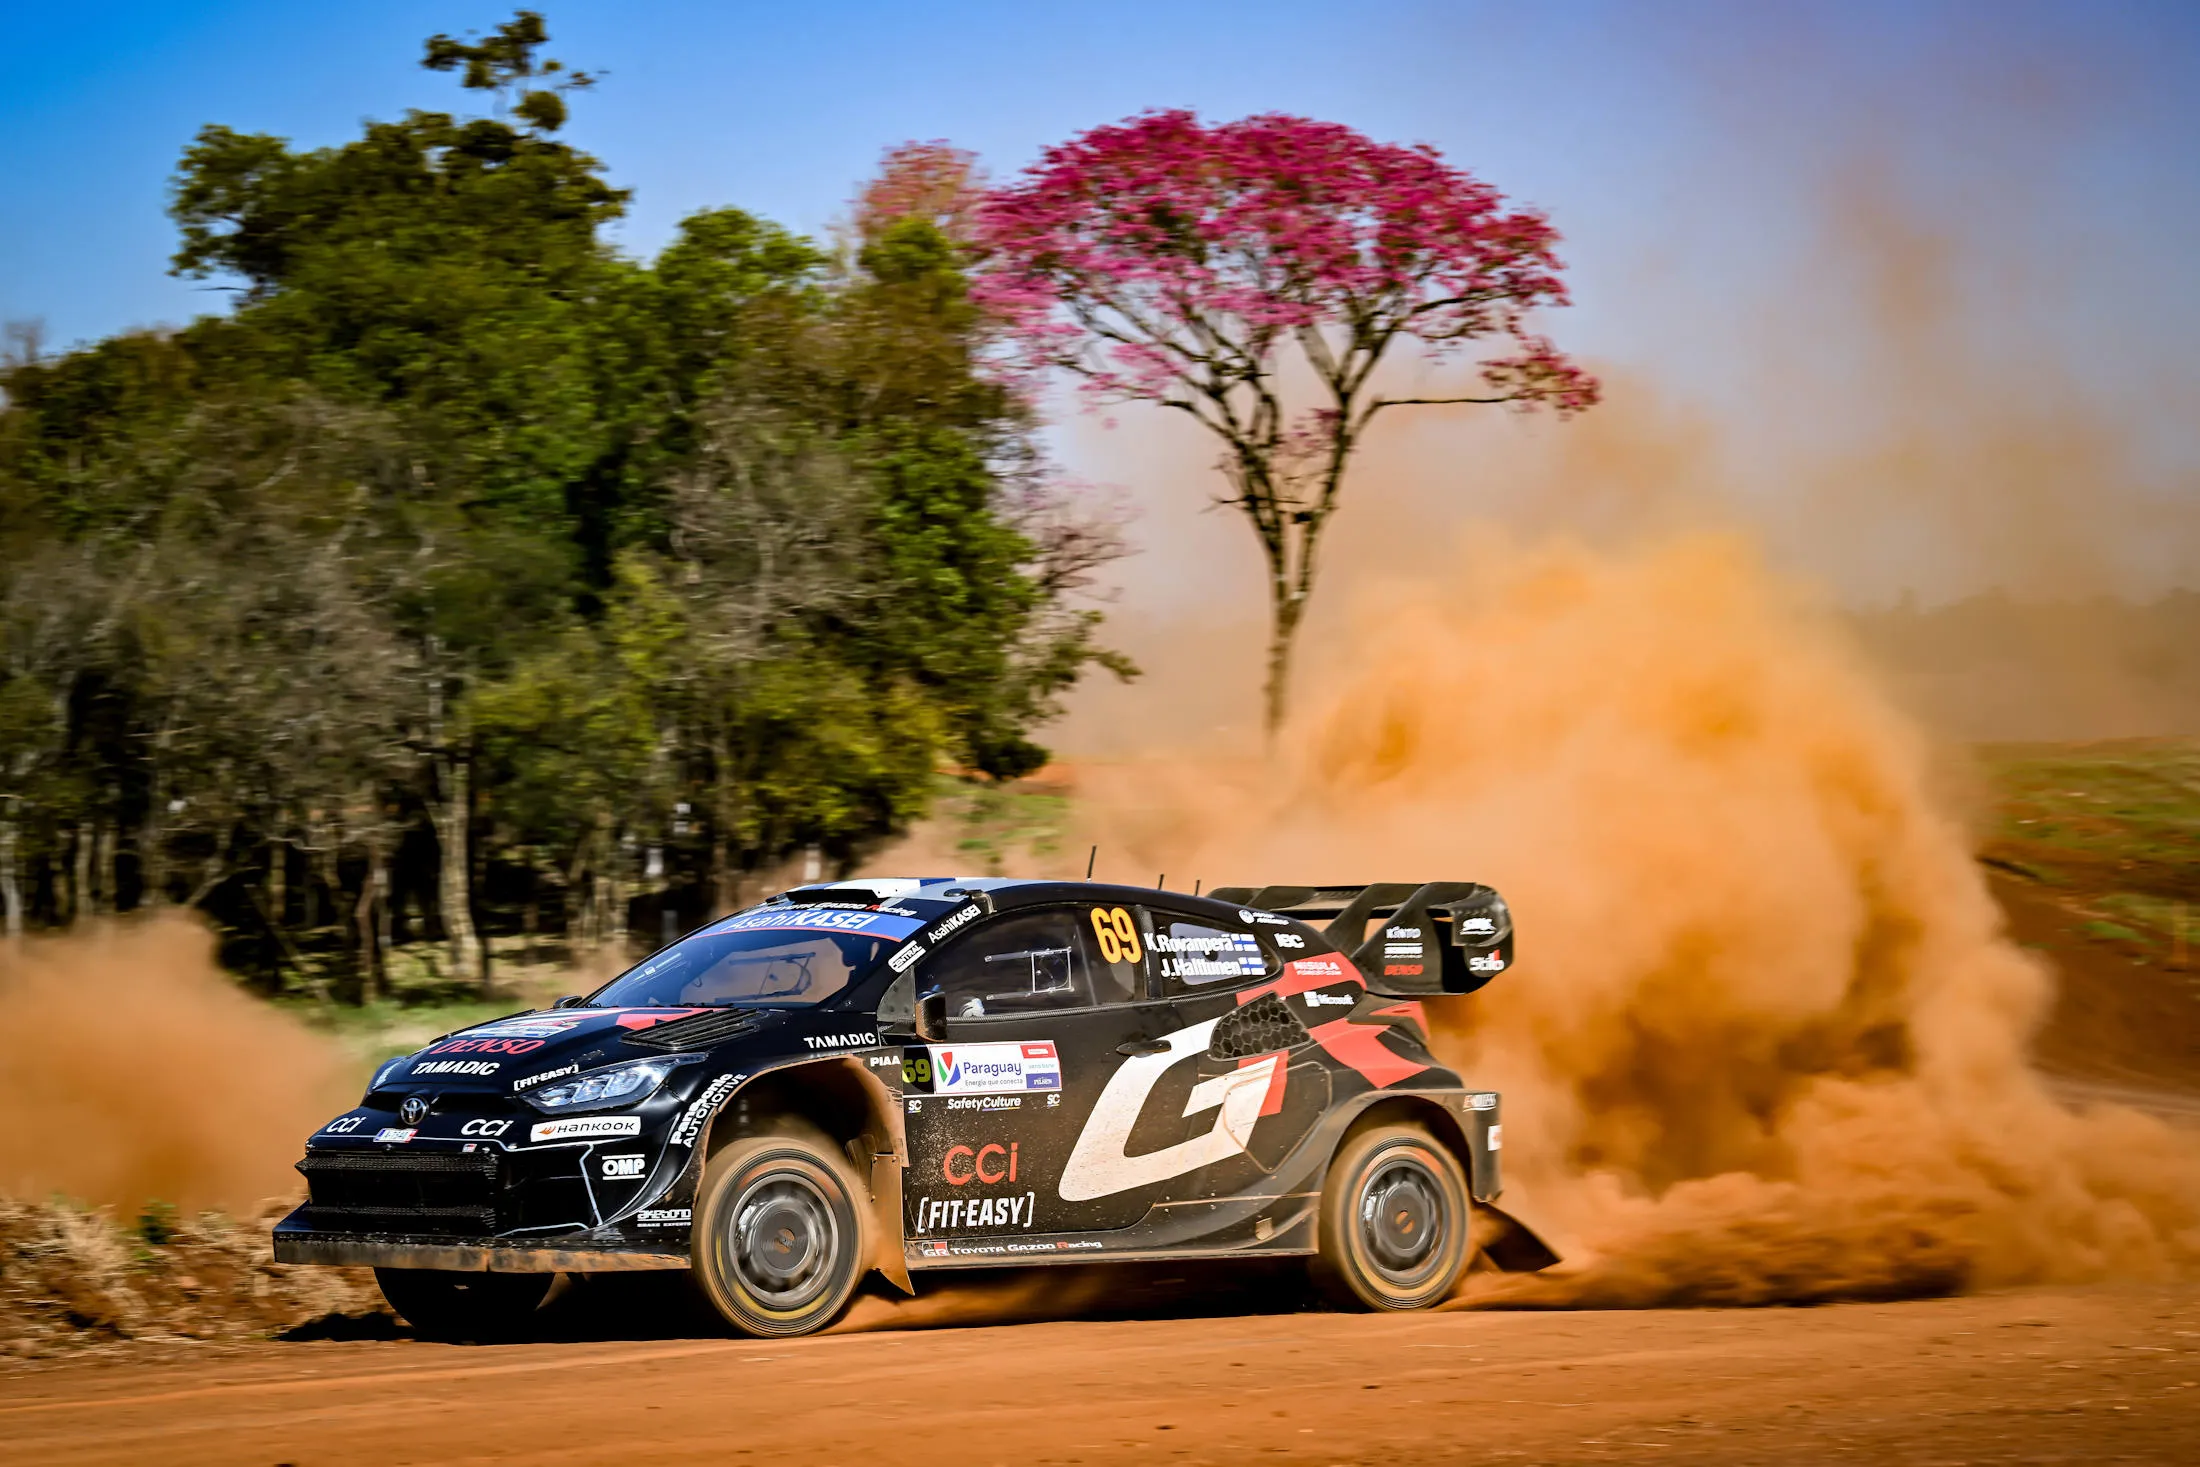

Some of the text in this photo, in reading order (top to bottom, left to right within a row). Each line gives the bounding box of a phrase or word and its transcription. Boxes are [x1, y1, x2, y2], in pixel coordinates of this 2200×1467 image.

[727, 908, 881, 930] AsahiKASEI
[928, 904, 981, 943] AsahiKASEI
[1090, 906, 1143, 964] 69
[1144, 932, 1235, 956] K.Rovanperä
[1161, 956, 1242, 978] J.Halttunen
[1469, 949, 1505, 972] Stilo
[429, 1038, 547, 1055] DENSO
[803, 1032, 876, 1049] TAMADIC
[411, 1060, 500, 1076] TAMADIC
[869, 1055, 901, 1067] PIAA
[903, 1058, 932, 1083] 69
[963, 1061, 1022, 1077] Paraguay
[513, 1063, 579, 1091] [FIT-EASY]
[669, 1073, 734, 1145] Panasonic
[908, 1099, 922, 1111] SC
[947, 1096, 1022, 1112] SafetyCulture
[1047, 1093, 1061, 1105] SC
[602, 1157, 646, 1177] OMP
[917, 1191, 1036, 1234] [FIT-EASY]
[951, 1246, 1005, 1256] TOYOTA
[1007, 1243, 1056, 1252] GAZOO
[1056, 1240, 1103, 1249] Racing
